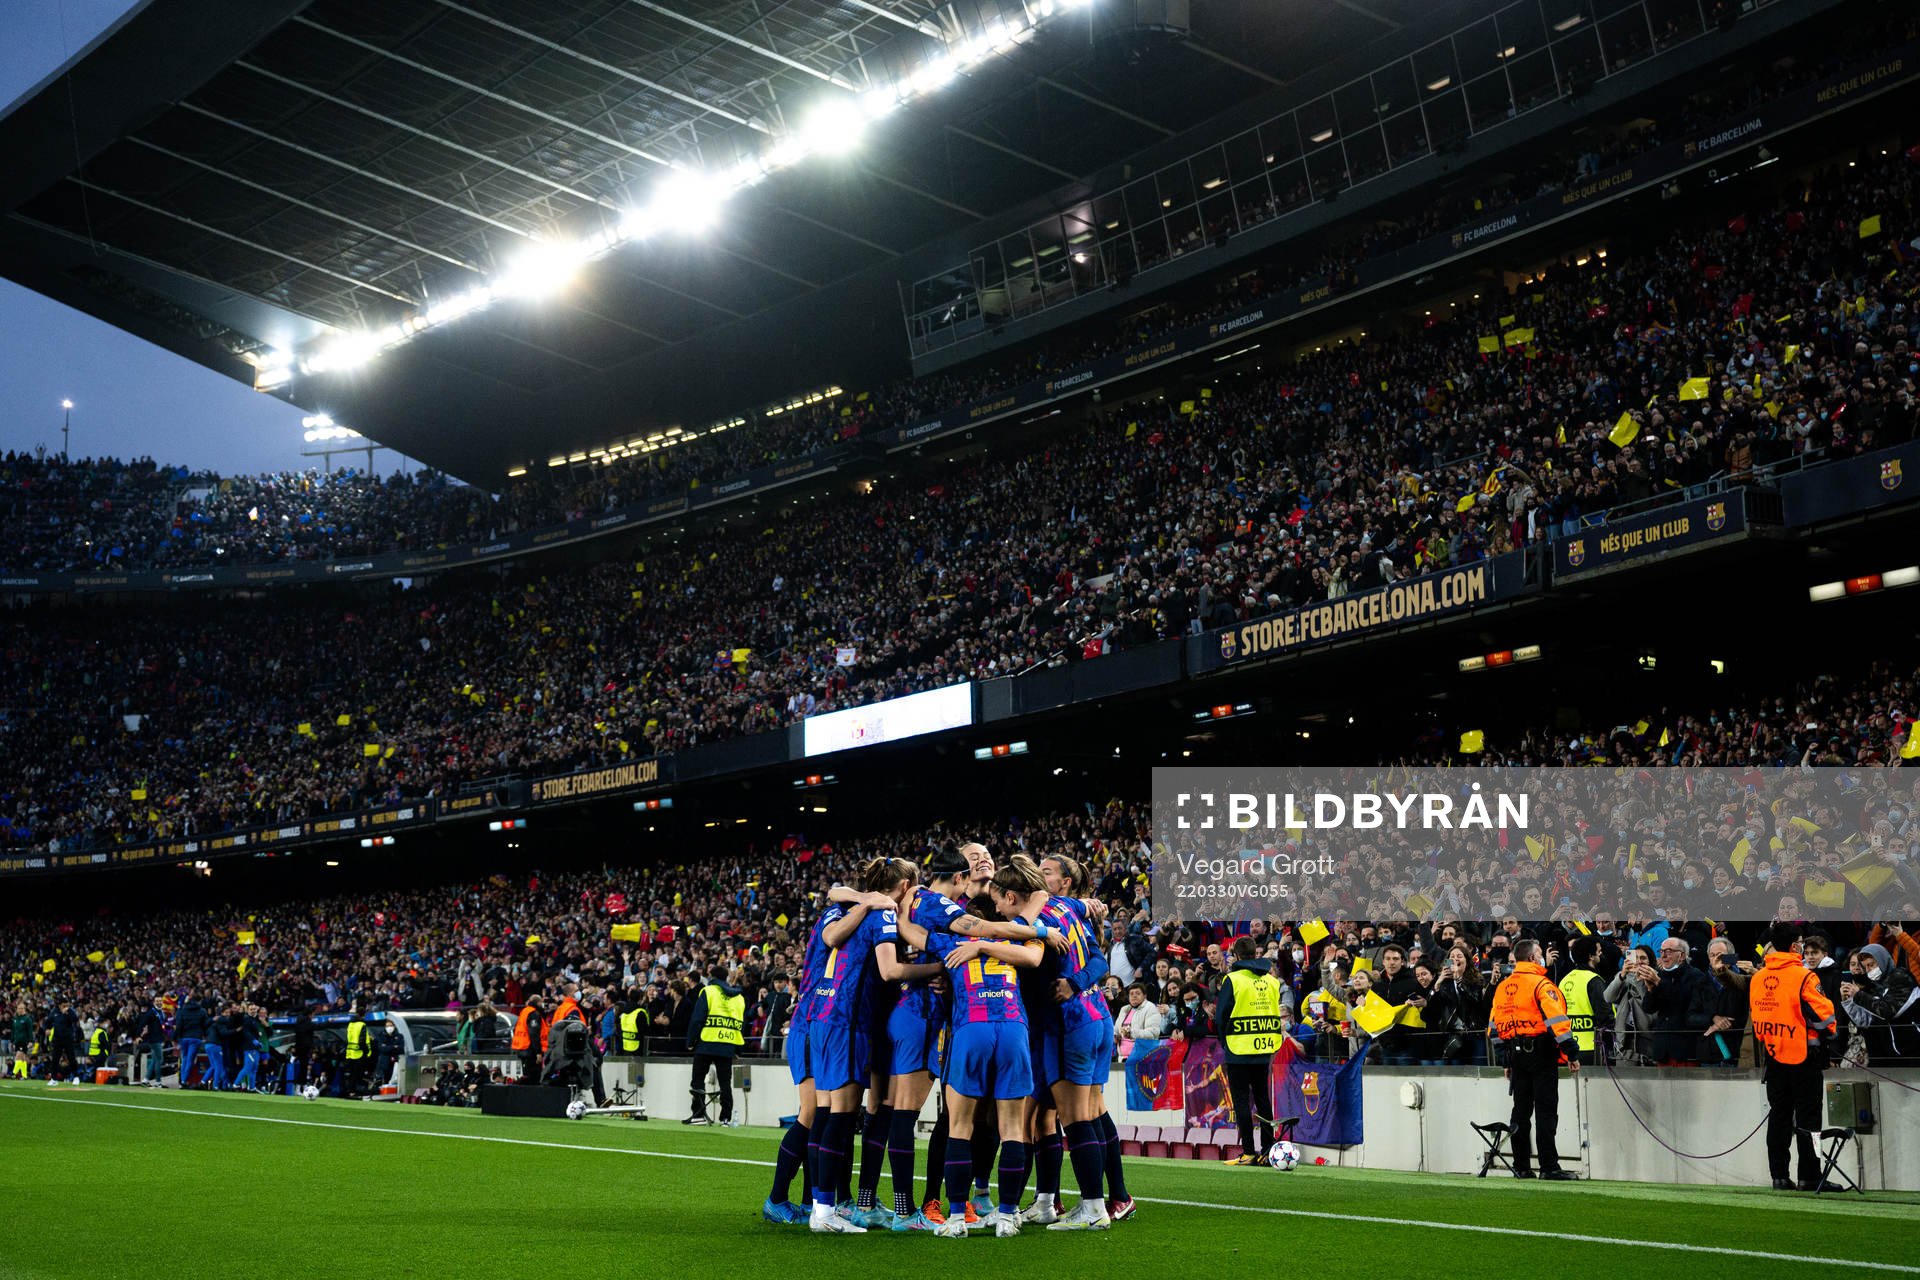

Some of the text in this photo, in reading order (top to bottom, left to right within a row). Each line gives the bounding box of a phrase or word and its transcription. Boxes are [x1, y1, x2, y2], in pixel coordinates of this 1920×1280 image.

[1839, 78, 1858, 96] QUE
[1860, 70, 1876, 86] UN
[1876, 59, 1903, 79] CLUB
[1698, 118, 1762, 152] FC BARCELONA
[1464, 215, 1518, 243] FC BARCELONA
[1219, 310, 1264, 333] FC BARCELONA
[1062, 371, 1094, 388] BARCELONA
[1600, 517, 1690, 554] MÉS QUE UN CLUB
[1241, 566, 1485, 656] STORE.FCBARCELONA.COM
[542, 760, 658, 800] STORE.FCBARCELONA.COM
[979, 990, 1005, 999] unicef
[1233, 1019, 1281, 1032] STEWAD
[1254, 1037, 1275, 1050] 034
